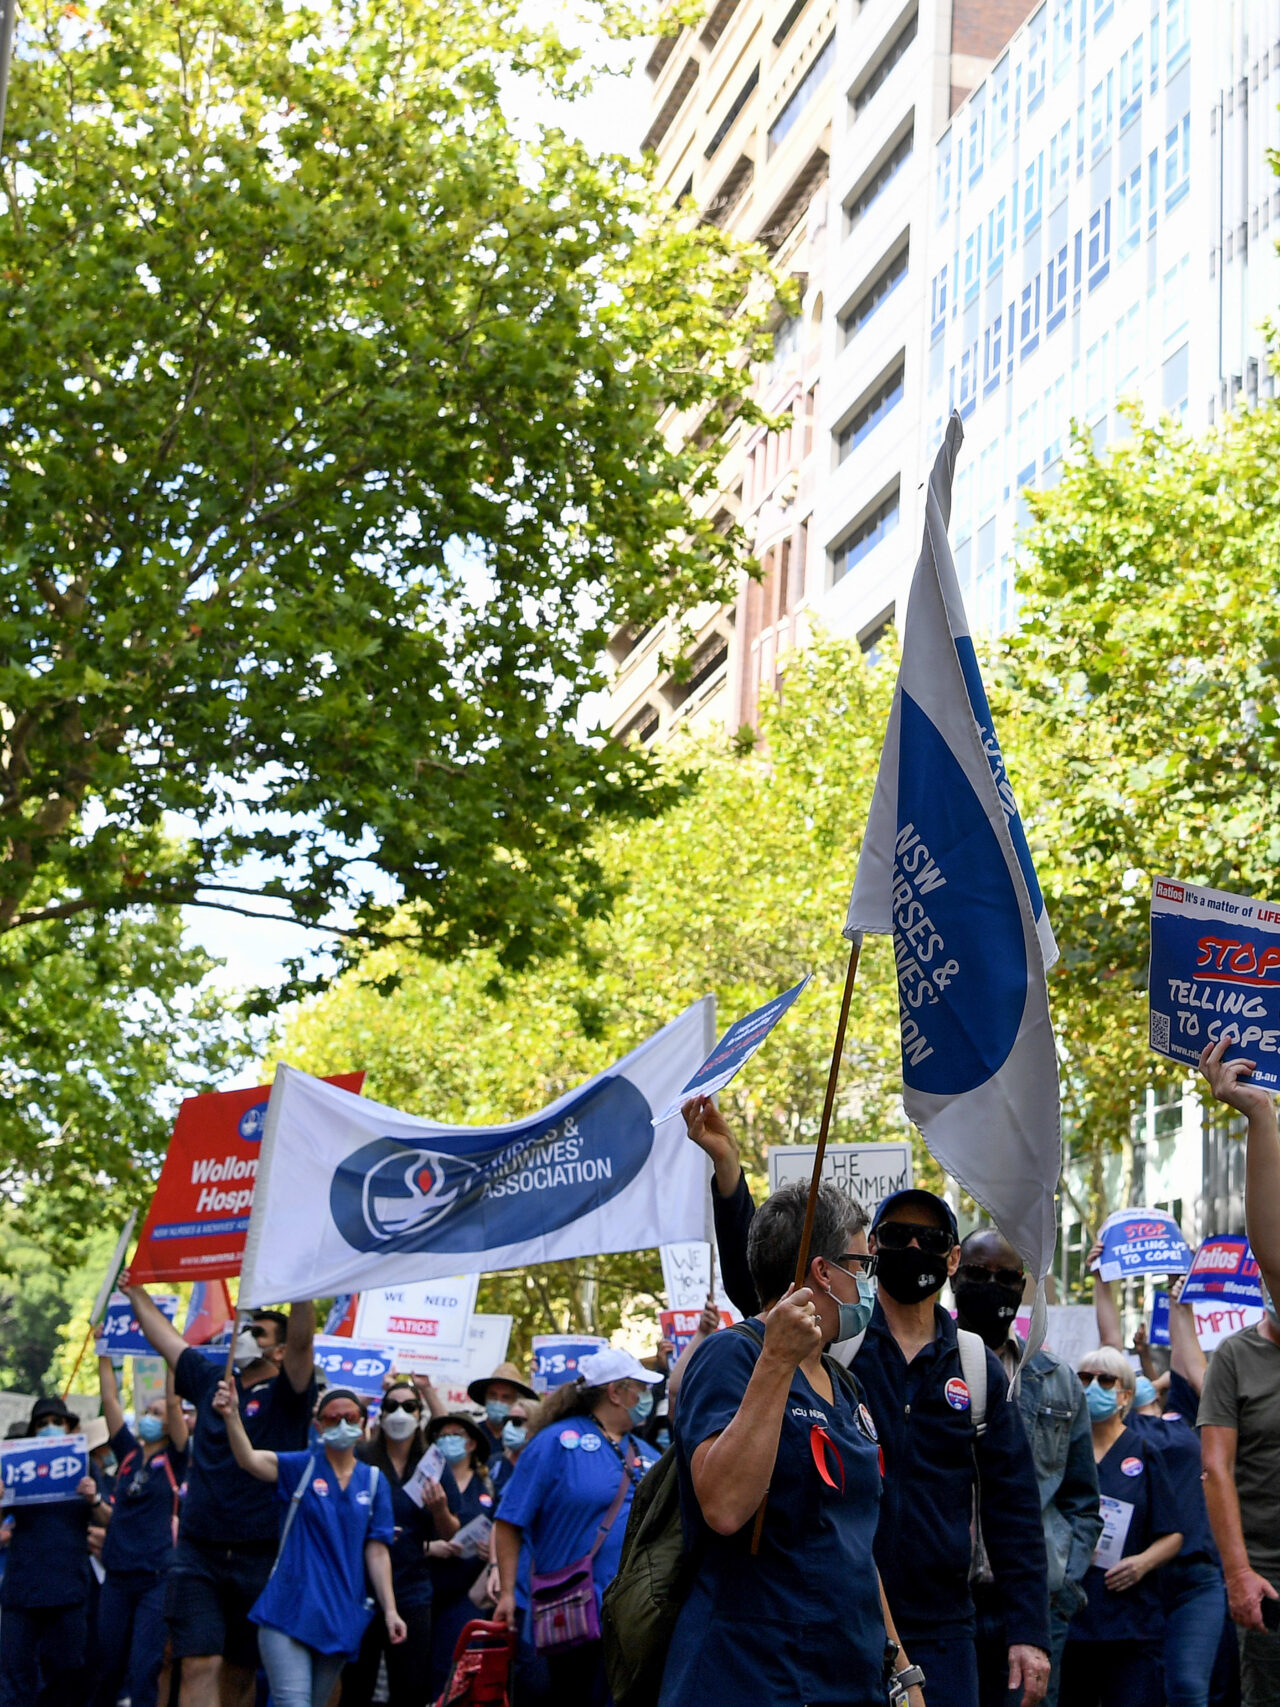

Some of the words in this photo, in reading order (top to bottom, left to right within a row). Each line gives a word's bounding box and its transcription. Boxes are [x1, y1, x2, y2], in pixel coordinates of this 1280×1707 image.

[896, 822, 948, 896] NSW
[1157, 884, 1183, 901] Ratios
[1185, 891, 1199, 904] It's
[1200, 897, 1205, 906] a
[1207, 899, 1240, 914] matter
[1241, 906, 1254, 917] of
[932, 959, 960, 992] &
[1168, 978, 1268, 1019] TELLING
[1176, 1010, 1200, 1036] TO
[563, 1116, 579, 1138] &
[480, 1157, 613, 1201] ASSOCIATION
[1124, 1222, 1167, 1239] STOP
[1112, 1240, 1170, 1256] TELLING
[1122, 1254, 1141, 1265] TO
[424, 1295, 459, 1308] NEED
[1194, 1308, 1247, 1335] MPTY
[352, 1358, 386, 1377] ED
[792, 1407, 807, 1417] ICU
[49, 1456, 83, 1480] ED
